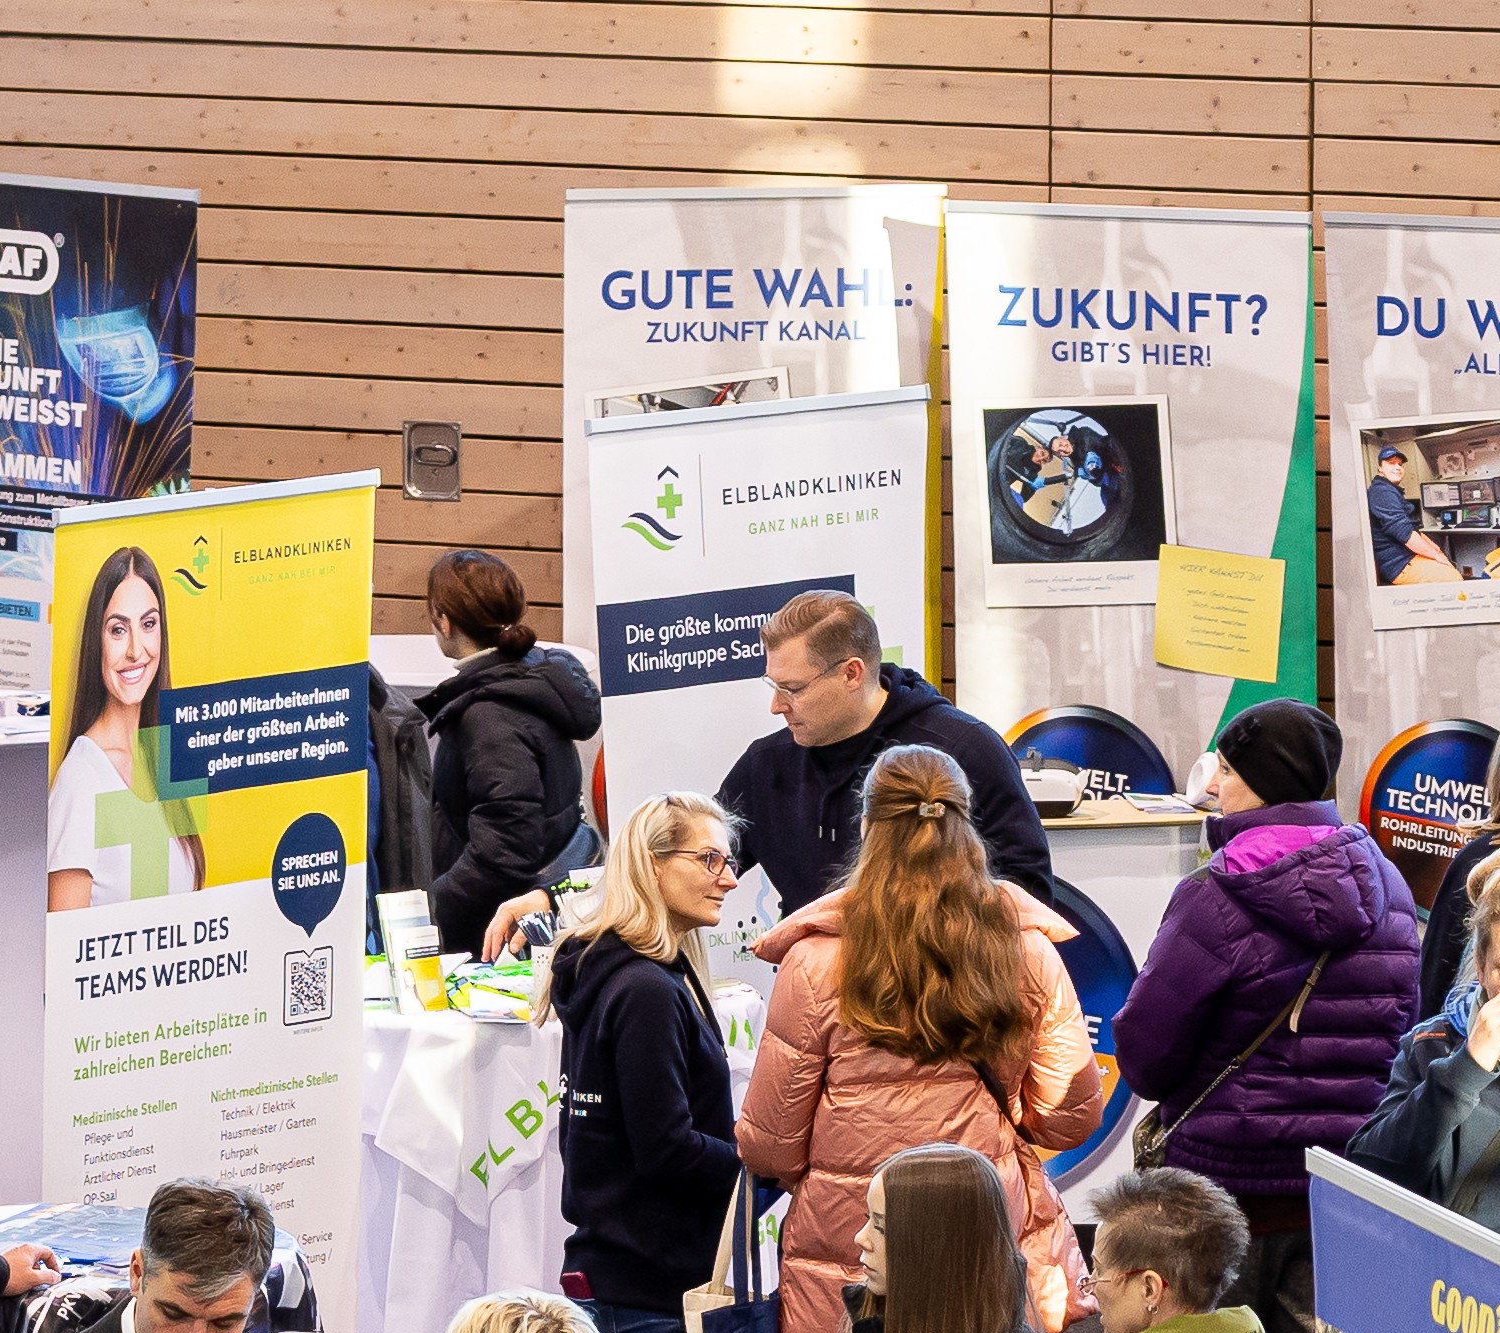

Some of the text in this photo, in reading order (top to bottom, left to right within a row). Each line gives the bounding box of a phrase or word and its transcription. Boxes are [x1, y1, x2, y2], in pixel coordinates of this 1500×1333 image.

[602, 269, 733, 311] GUTE
[997, 284, 1268, 337] ZUKUNFT?
[1376, 295, 1446, 339] DU
[646, 320, 866, 343] ZUKUNFT KANAL
[1143, 344, 1212, 368] HIER!
[16, 493, 34, 503] zum
[722, 469, 902, 505] ELBLANDKLINIKEN
[748, 508, 879, 534] GANZ NAH BEI MIR
[234, 537, 351, 564] ELBLANDKLINIKEN
[625, 617, 710, 646] Die größte
[627, 642, 727, 673] Klinikgruppe
[176, 687, 349, 724] Mit 3.000 MitarbeiterInnen
[188, 711, 349, 749] einer der größten Arbeit-
[282, 850, 338, 872] SPRECHEN
[278, 869, 341, 891] SIE UNS AN.
[76, 916, 229, 963] JETZT TEIL DES
[75, 950, 248, 1001] TEAMS WERDEN!
[74, 1008, 267, 1054] Wir bieten Arbeitsplätze in
[74, 1041, 232, 1082] zahlreichen Bereichen:
[73, 1100, 178, 1127] Medizinische Stellen
[84, 1144, 154, 1166] Funktionsdienst
[220, 1144, 259, 1162] Fuhrpark
